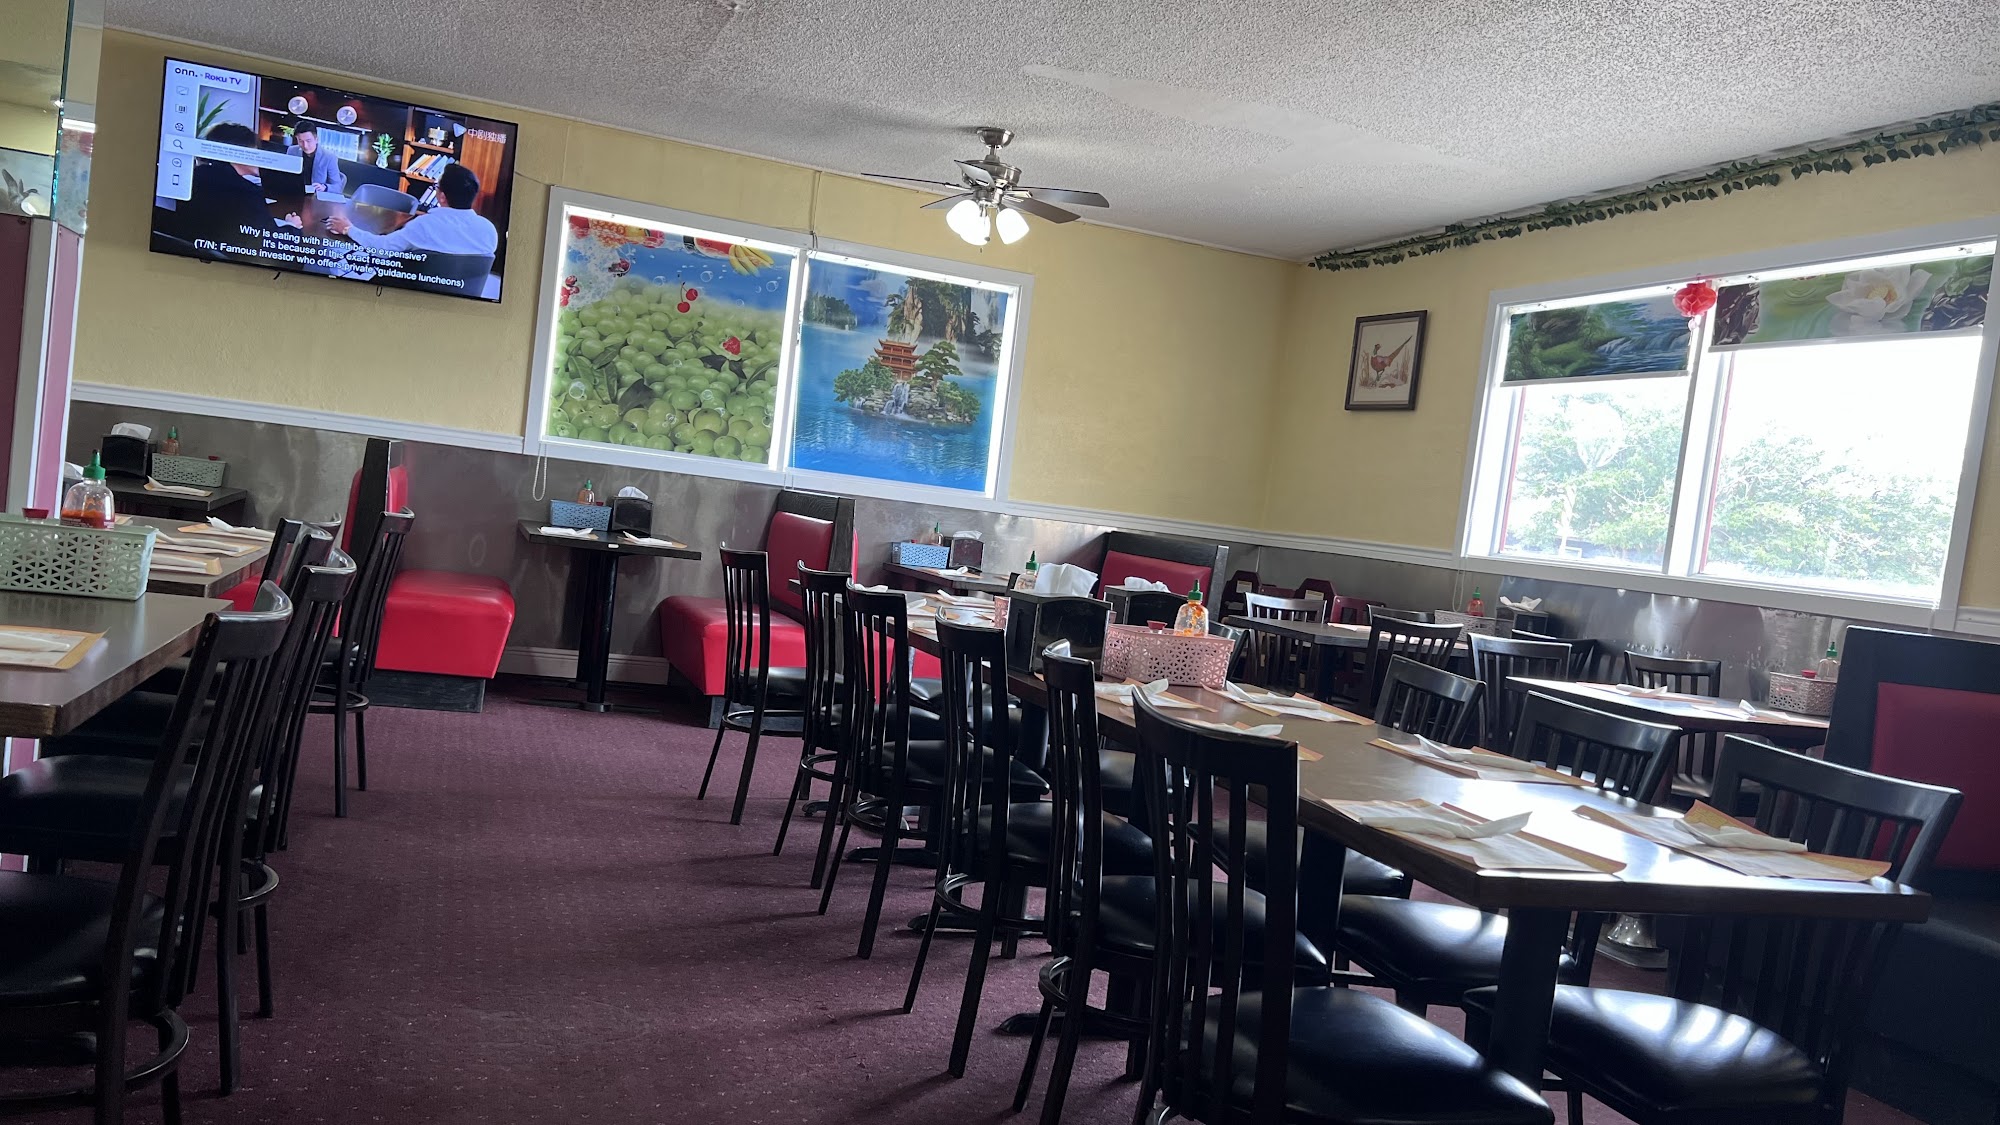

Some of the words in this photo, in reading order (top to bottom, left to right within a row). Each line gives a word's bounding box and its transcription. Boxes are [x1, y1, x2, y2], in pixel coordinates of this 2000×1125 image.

[175, 68, 198, 78] onn.
[229, 77, 241, 85] TV
[240, 225, 261, 237] Why
[262, 229, 271, 238] is
[272, 232, 300, 244] eating
[302, 236, 321, 245] with
[322, 238, 351, 250] Buffett
[353, 244, 365, 252] be
[366, 246, 377, 254] so
[378, 248, 428, 262] expensive?
[263, 239, 276, 249] It's
[278, 242, 316, 255] because
[318, 248, 327, 257] of
[328, 250, 345, 259] this
[346, 254, 370, 264] exact
[372, 258, 404, 269] reason.
[194, 239, 218, 250] (T/N:
[220, 243, 257, 257] Famous
[260, 248, 295, 262] investor
[296, 256, 315, 265] who
[317, 258, 342, 269] offers
[344, 262, 374, 274] private
[419, 273, 465, 289] luncheons)
